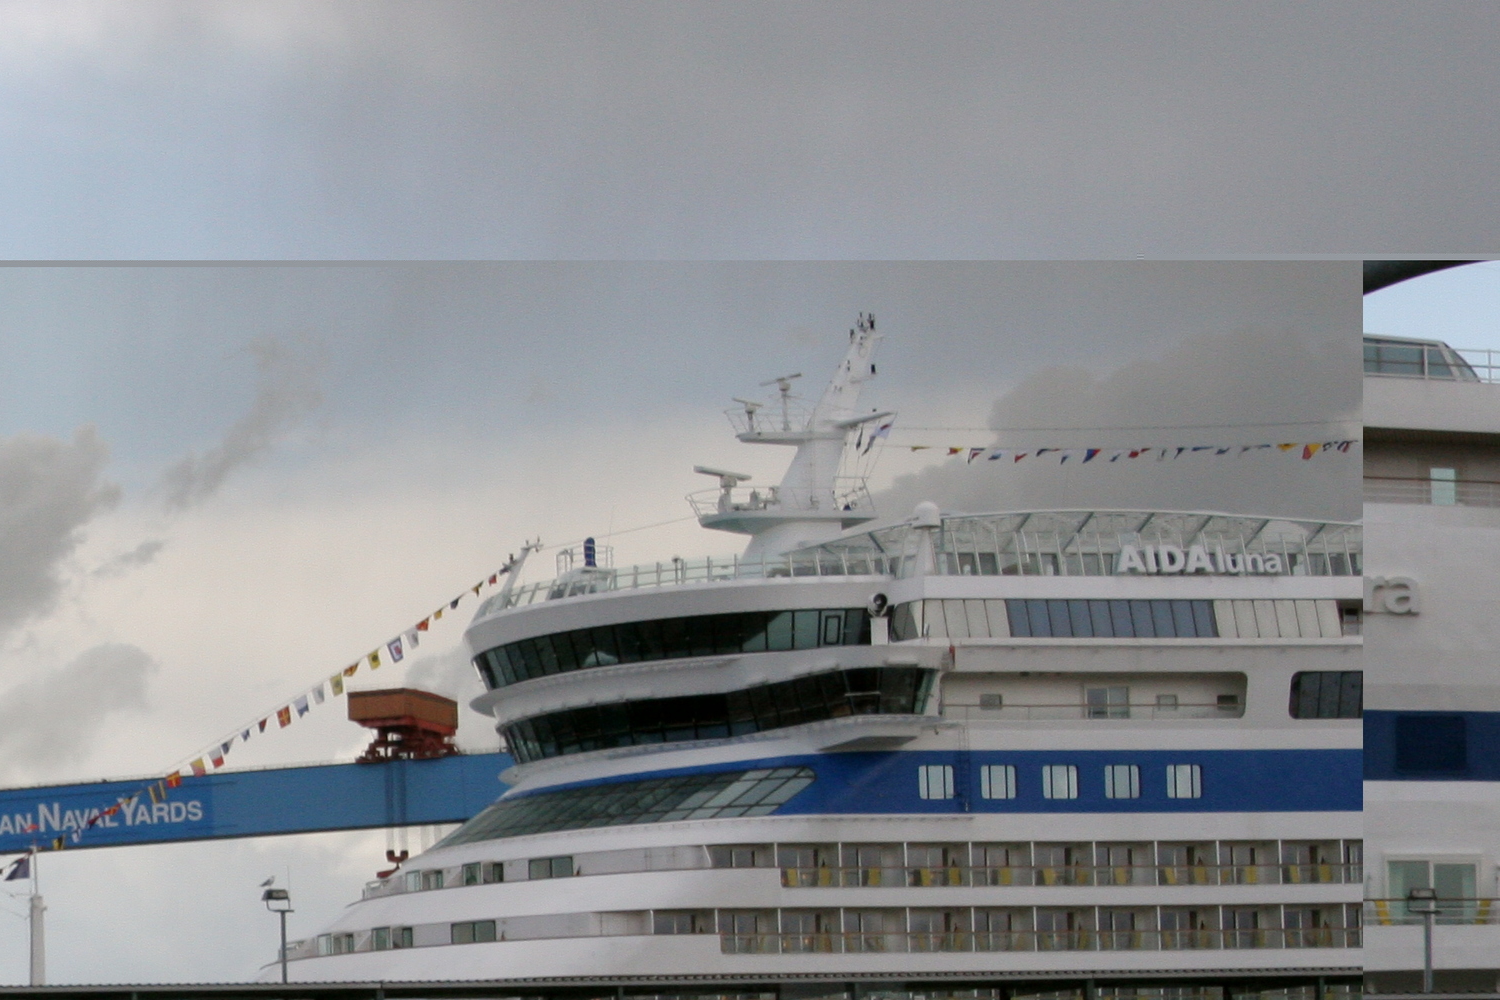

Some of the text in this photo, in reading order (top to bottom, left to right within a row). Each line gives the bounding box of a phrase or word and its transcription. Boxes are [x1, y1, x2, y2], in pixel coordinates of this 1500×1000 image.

[1117, 545, 1283, 574] AIDAluna
[37, 802, 119, 834] NAVAL
[116, 796, 204, 827] YARDS
